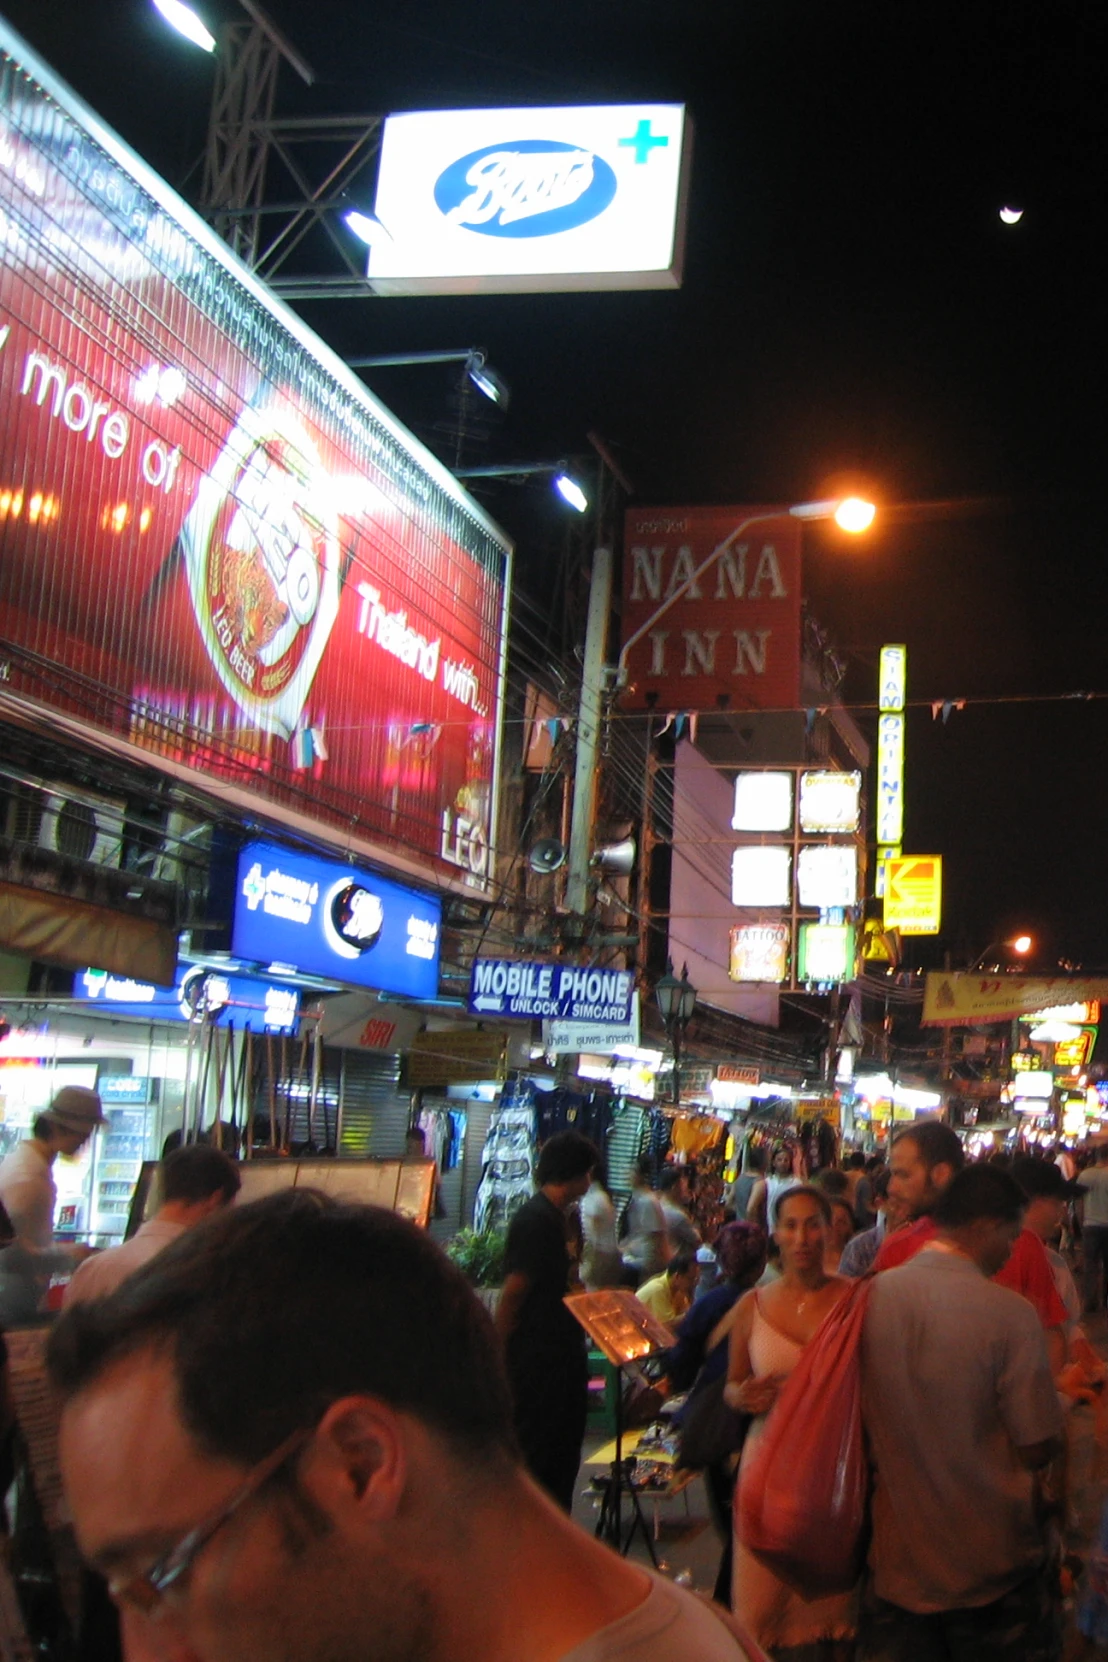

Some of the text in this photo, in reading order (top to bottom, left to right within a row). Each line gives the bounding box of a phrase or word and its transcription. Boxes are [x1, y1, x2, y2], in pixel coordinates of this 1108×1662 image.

[20, 349, 184, 495] more of
[630, 544, 788, 600] NANA
[212, 609, 257, 691] LEO BEER
[357, 580, 441, 683] Thailand
[648, 628, 772, 677] INN
[881, 649, 902, 708] SIAM
[880, 714, 899, 842] ORIENTAL
[441, 804, 488, 875] LEO
[734, 929, 785, 942] TATTOO
[474, 960, 629, 1006] MOBILE PHONE
[510, 999, 558, 1016] UNLOCK
[572, 1004, 626, 1021] SIMCARD
[359, 1017, 396, 1048] SIRI
